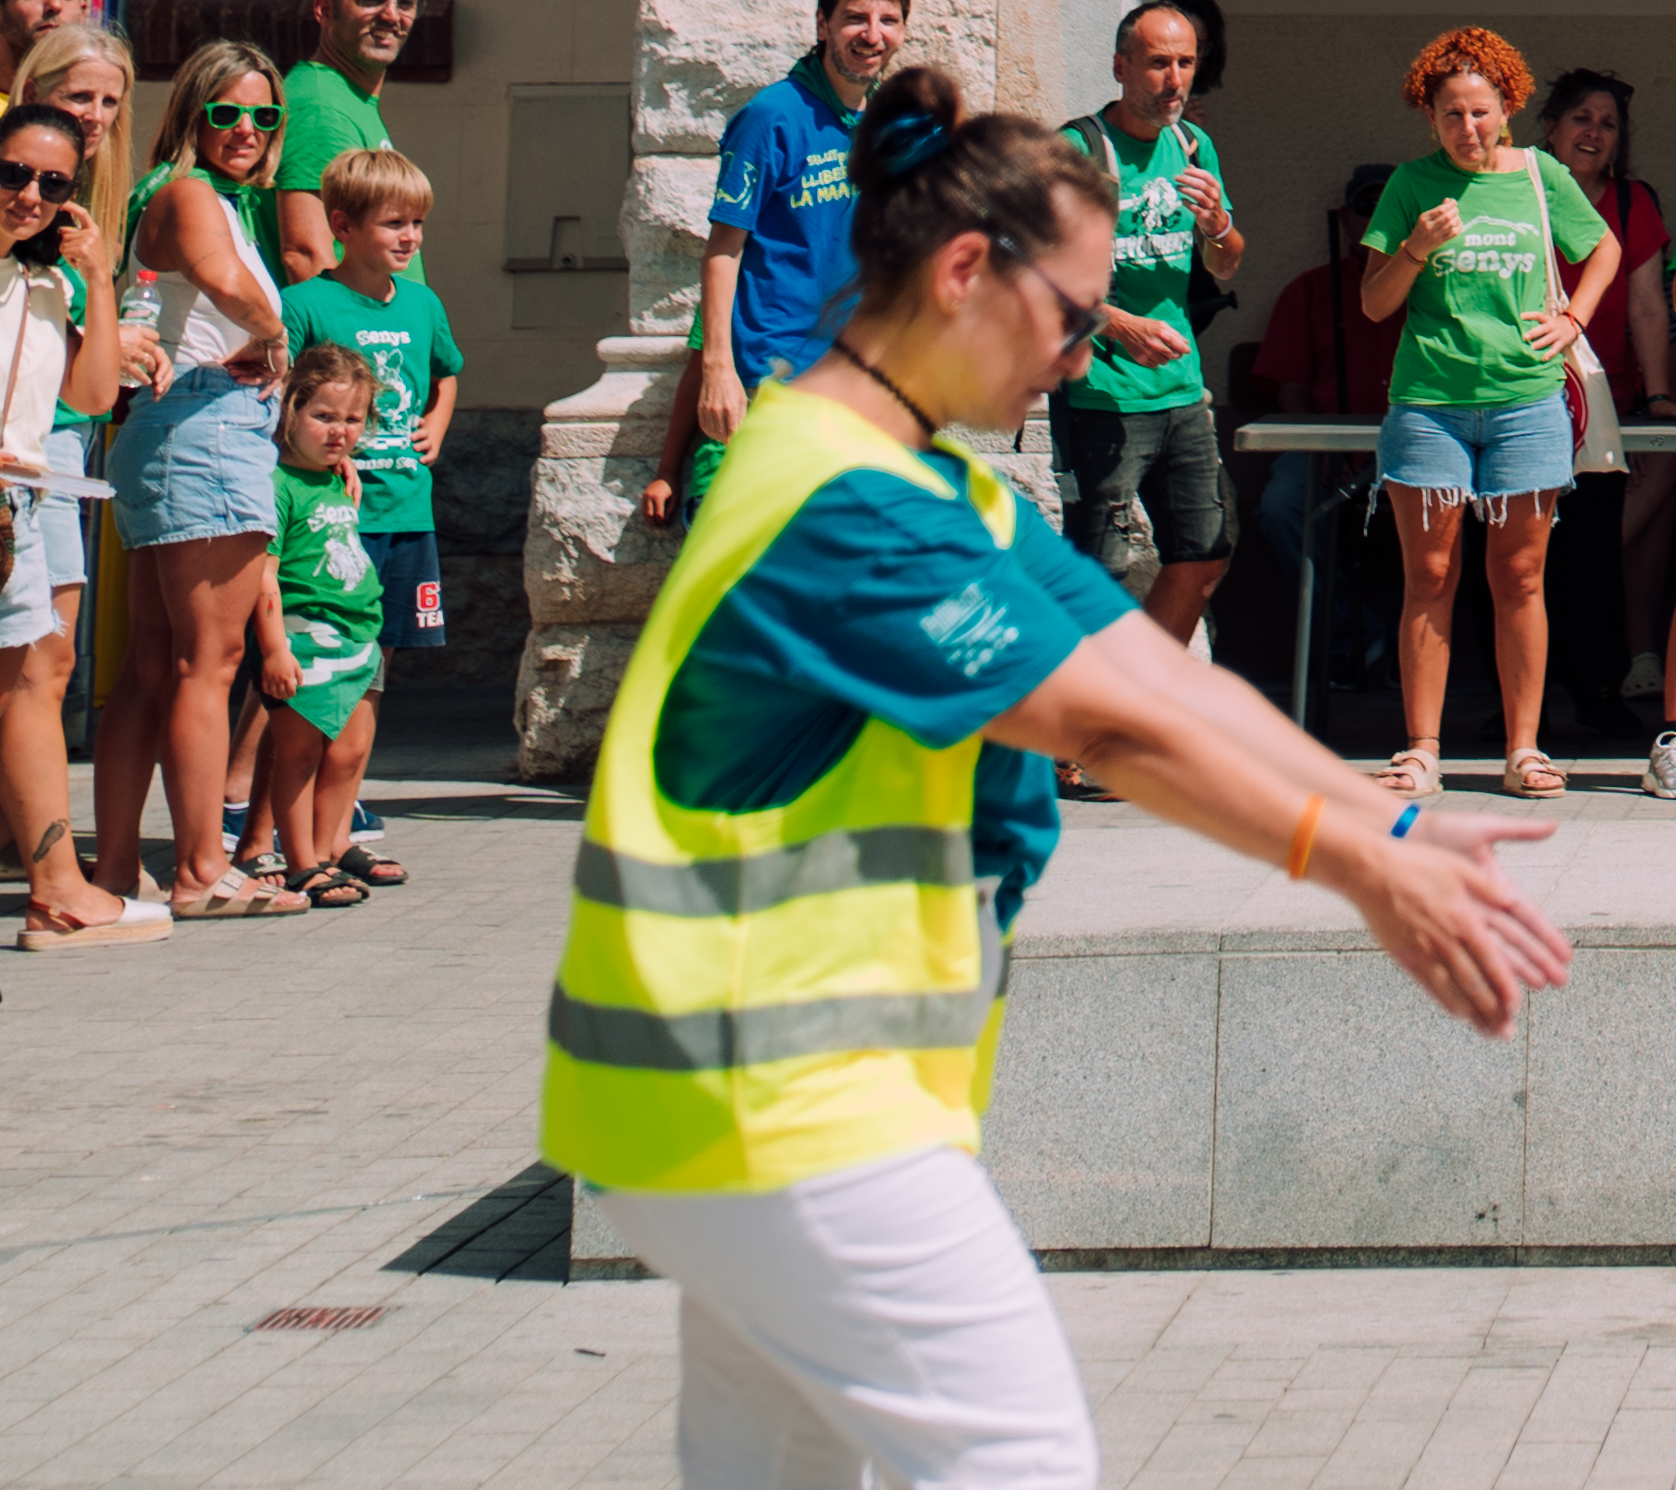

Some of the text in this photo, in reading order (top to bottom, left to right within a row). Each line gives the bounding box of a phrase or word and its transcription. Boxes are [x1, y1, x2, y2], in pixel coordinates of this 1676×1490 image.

[1464, 231, 1518, 247] mont
[1431, 248, 1537, 280] Senys
[355, 329, 412, 347] Senys
[416, 609, 445, 630] TEA
